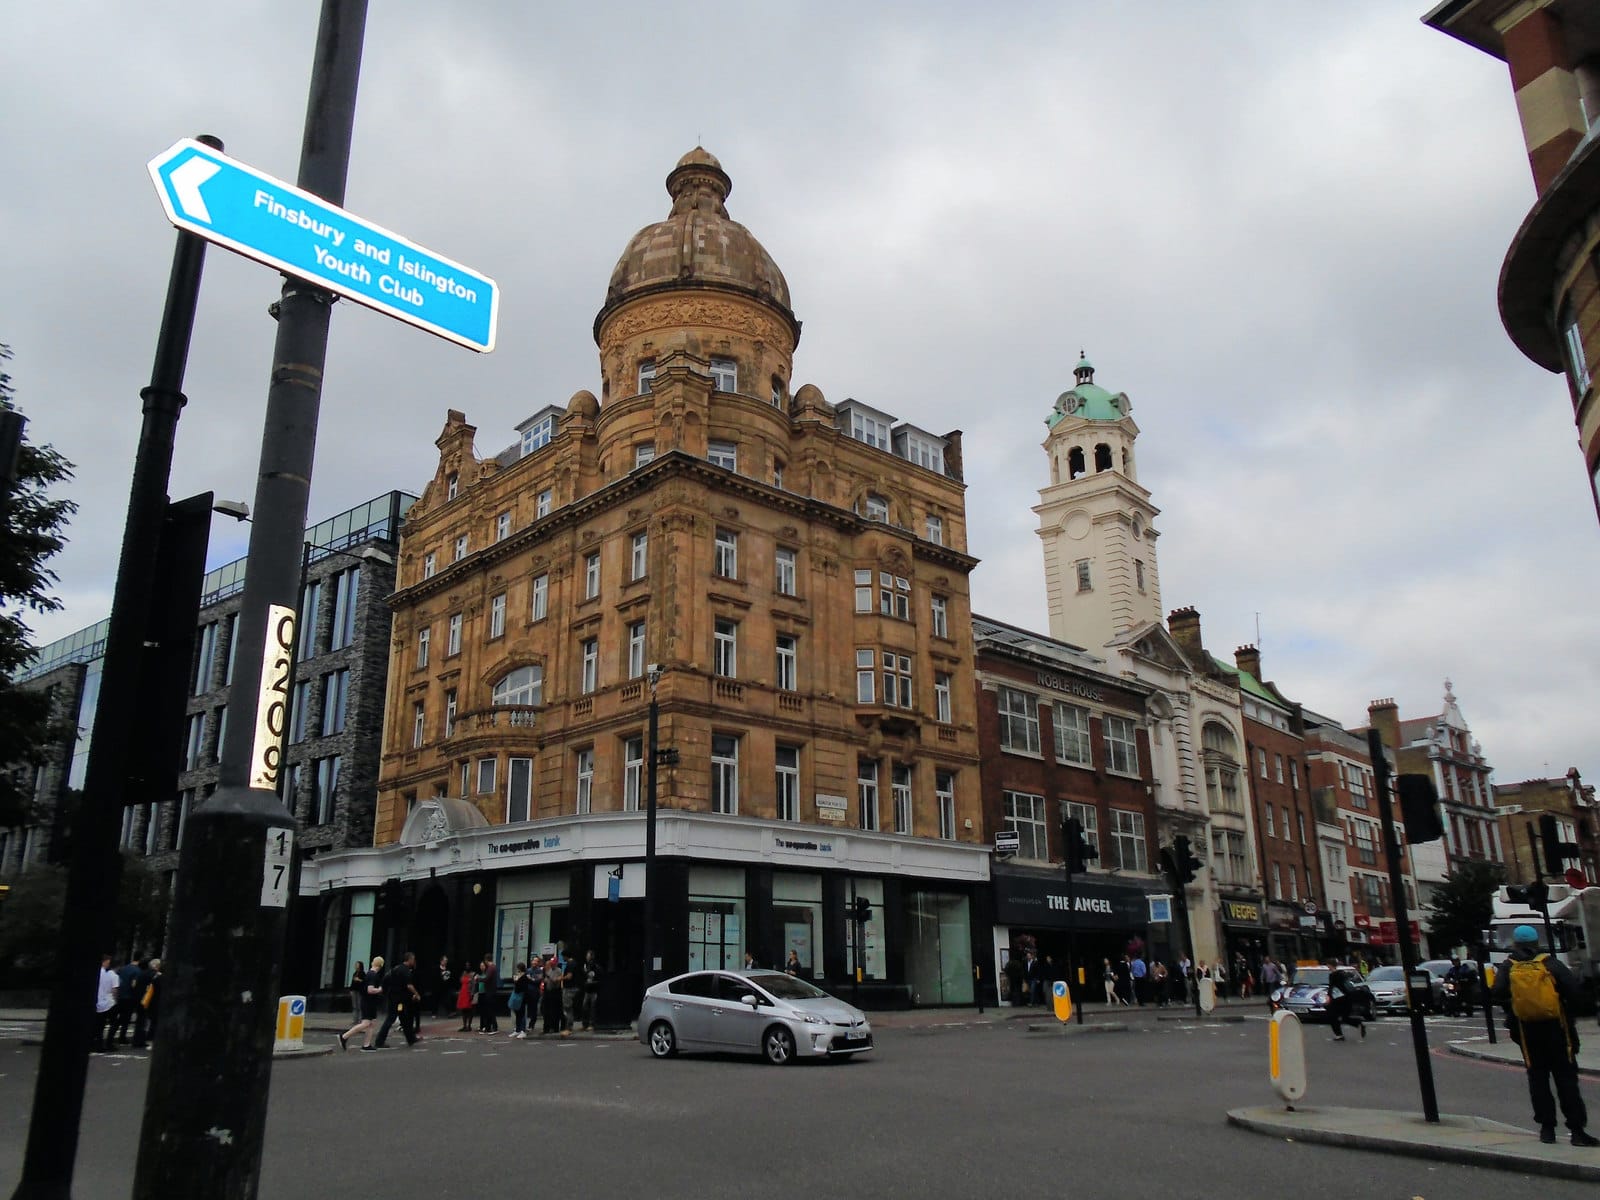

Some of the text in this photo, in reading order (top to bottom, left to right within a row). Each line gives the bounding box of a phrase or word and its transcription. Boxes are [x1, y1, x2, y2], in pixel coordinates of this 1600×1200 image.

[254, 189, 477, 304] Finsbury and Islington
[314, 244, 424, 307] Youth Club
[1037, 672, 1104, 702] NOBLE HOUSE
[543, 835, 560, 848] bank
[1047, 895, 1070, 911] THE
[1075, 897, 1113, 914] ANGEL
[1229, 903, 1258, 921] VEGAS
